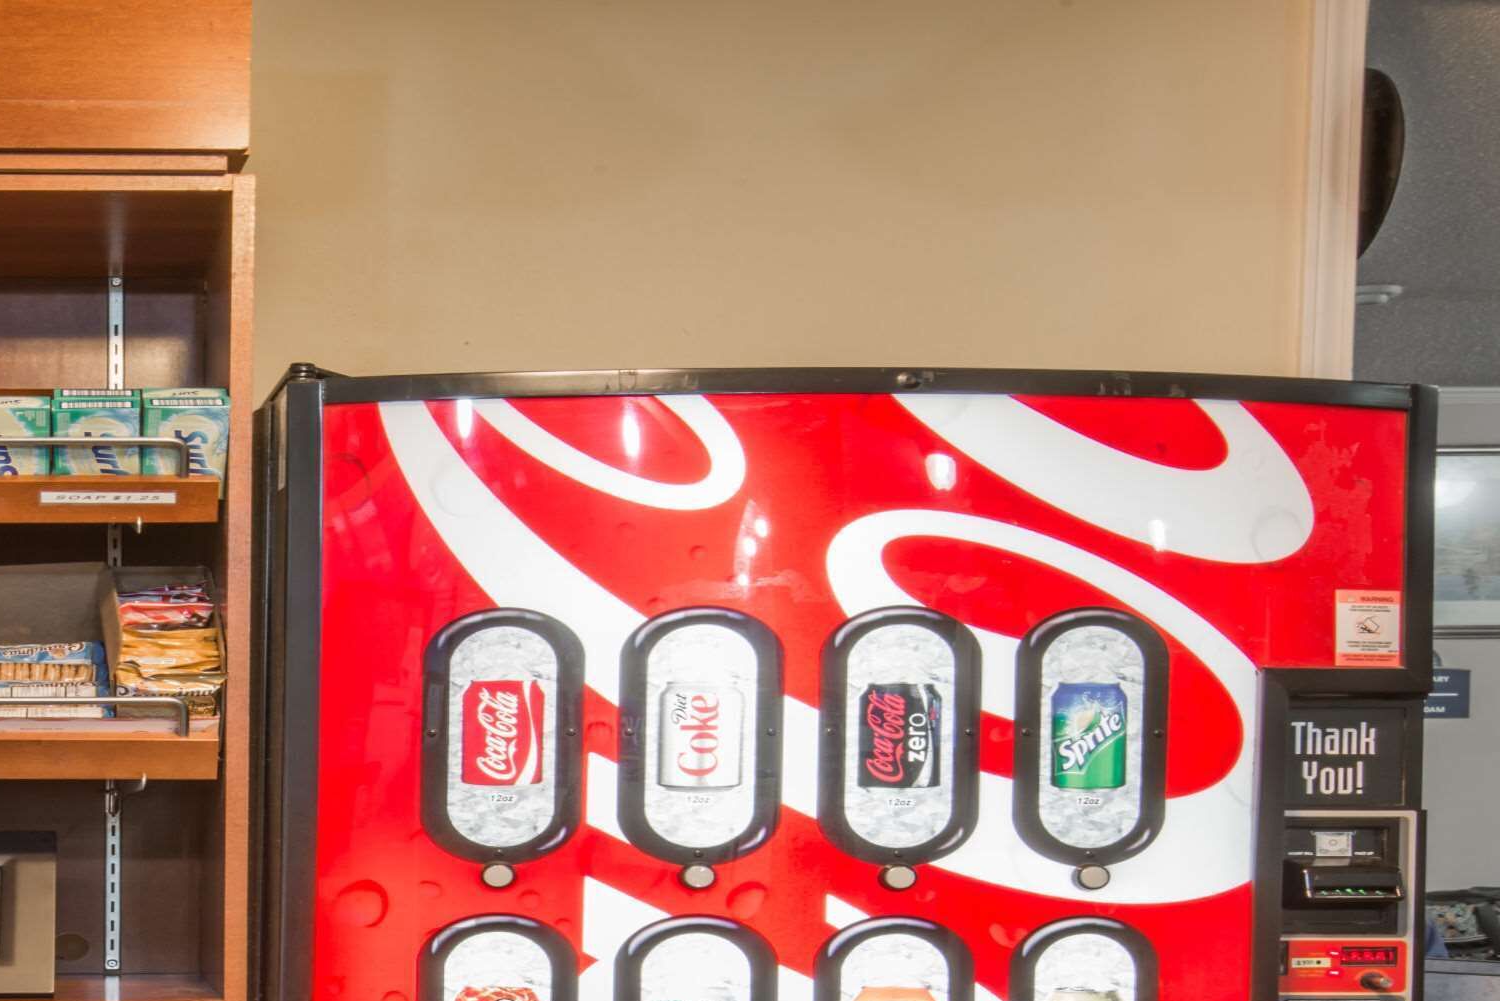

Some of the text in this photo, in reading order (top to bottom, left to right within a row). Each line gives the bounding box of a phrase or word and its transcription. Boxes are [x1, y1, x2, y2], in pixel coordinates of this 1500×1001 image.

[670, 692, 689, 726] Diet
[676, 693, 721, 778] Coke
[908, 711, 927, 764] zero
[1056, 708, 1123, 774] Sprite
[1291, 721, 1376, 755] Thank
[1302, 760, 1364, 795] You!
[490, 793, 515, 803] 12oz
[887, 797, 912, 807] 12oz
[1077, 795, 1101, 806] 12oz
